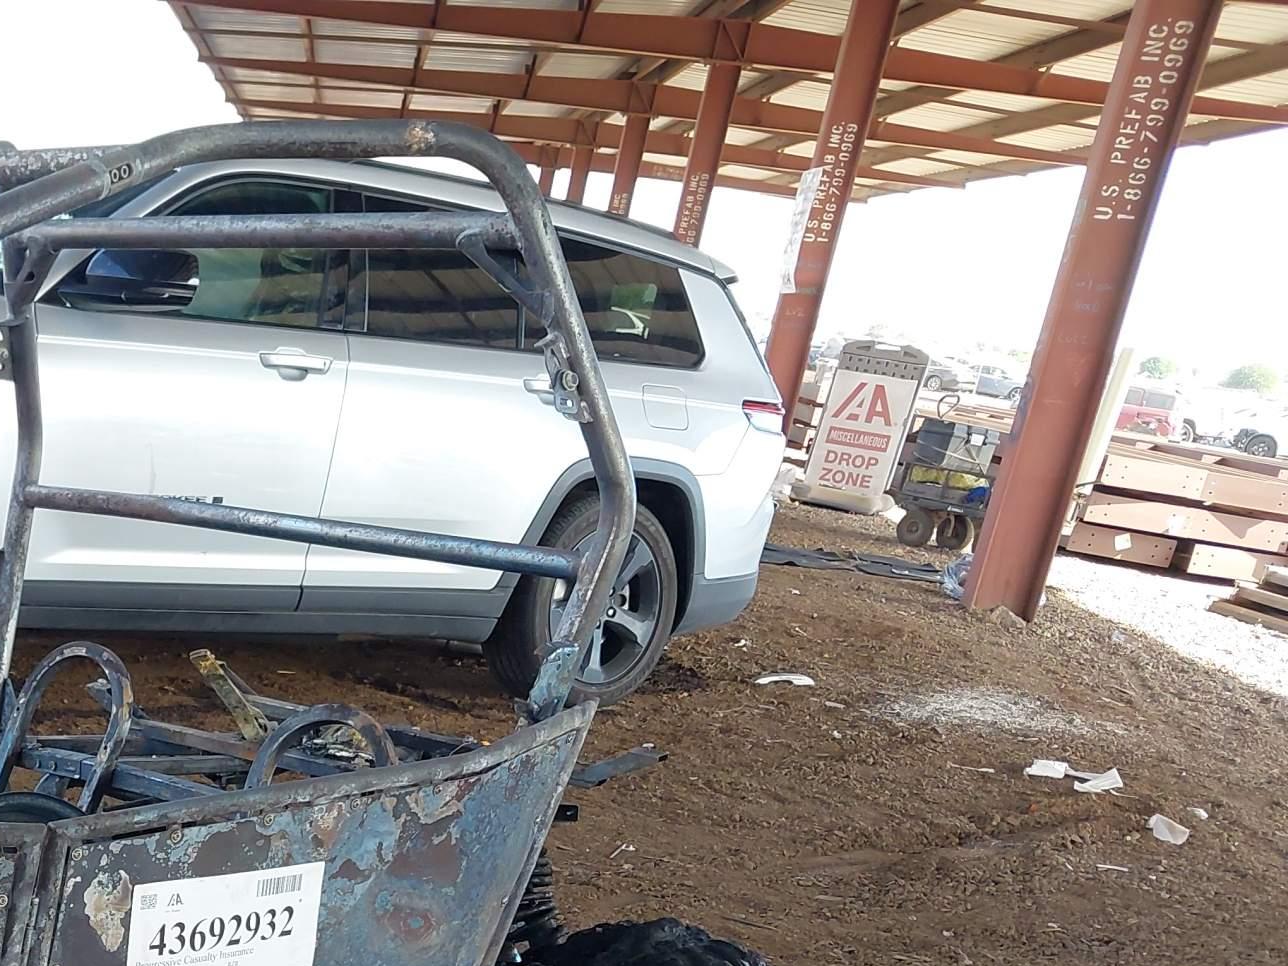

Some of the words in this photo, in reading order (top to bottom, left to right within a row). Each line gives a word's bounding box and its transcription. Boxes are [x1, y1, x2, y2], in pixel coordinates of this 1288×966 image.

[1093, 178, 1123, 220] U.S.
[1110, 75, 1153, 164] PREFAB
[1141, 17, 1173, 62] INC.
[1116, 19, 1195, 220] 1-866-799-0969
[803, 215, 822, 242] U.S.
[813, 154, 837, 208] PREFAB
[827, 120, 846, 148] INC.
[828, 429, 888, 449] MISCELLANEOUS
[818, 467, 873, 488] ZONE
[824, 449, 879, 470] DROP
[149, 905, 294, 956] 43692932
[184, 952, 217, 965] Casualty
[219, 947, 255, 960] Insurance
